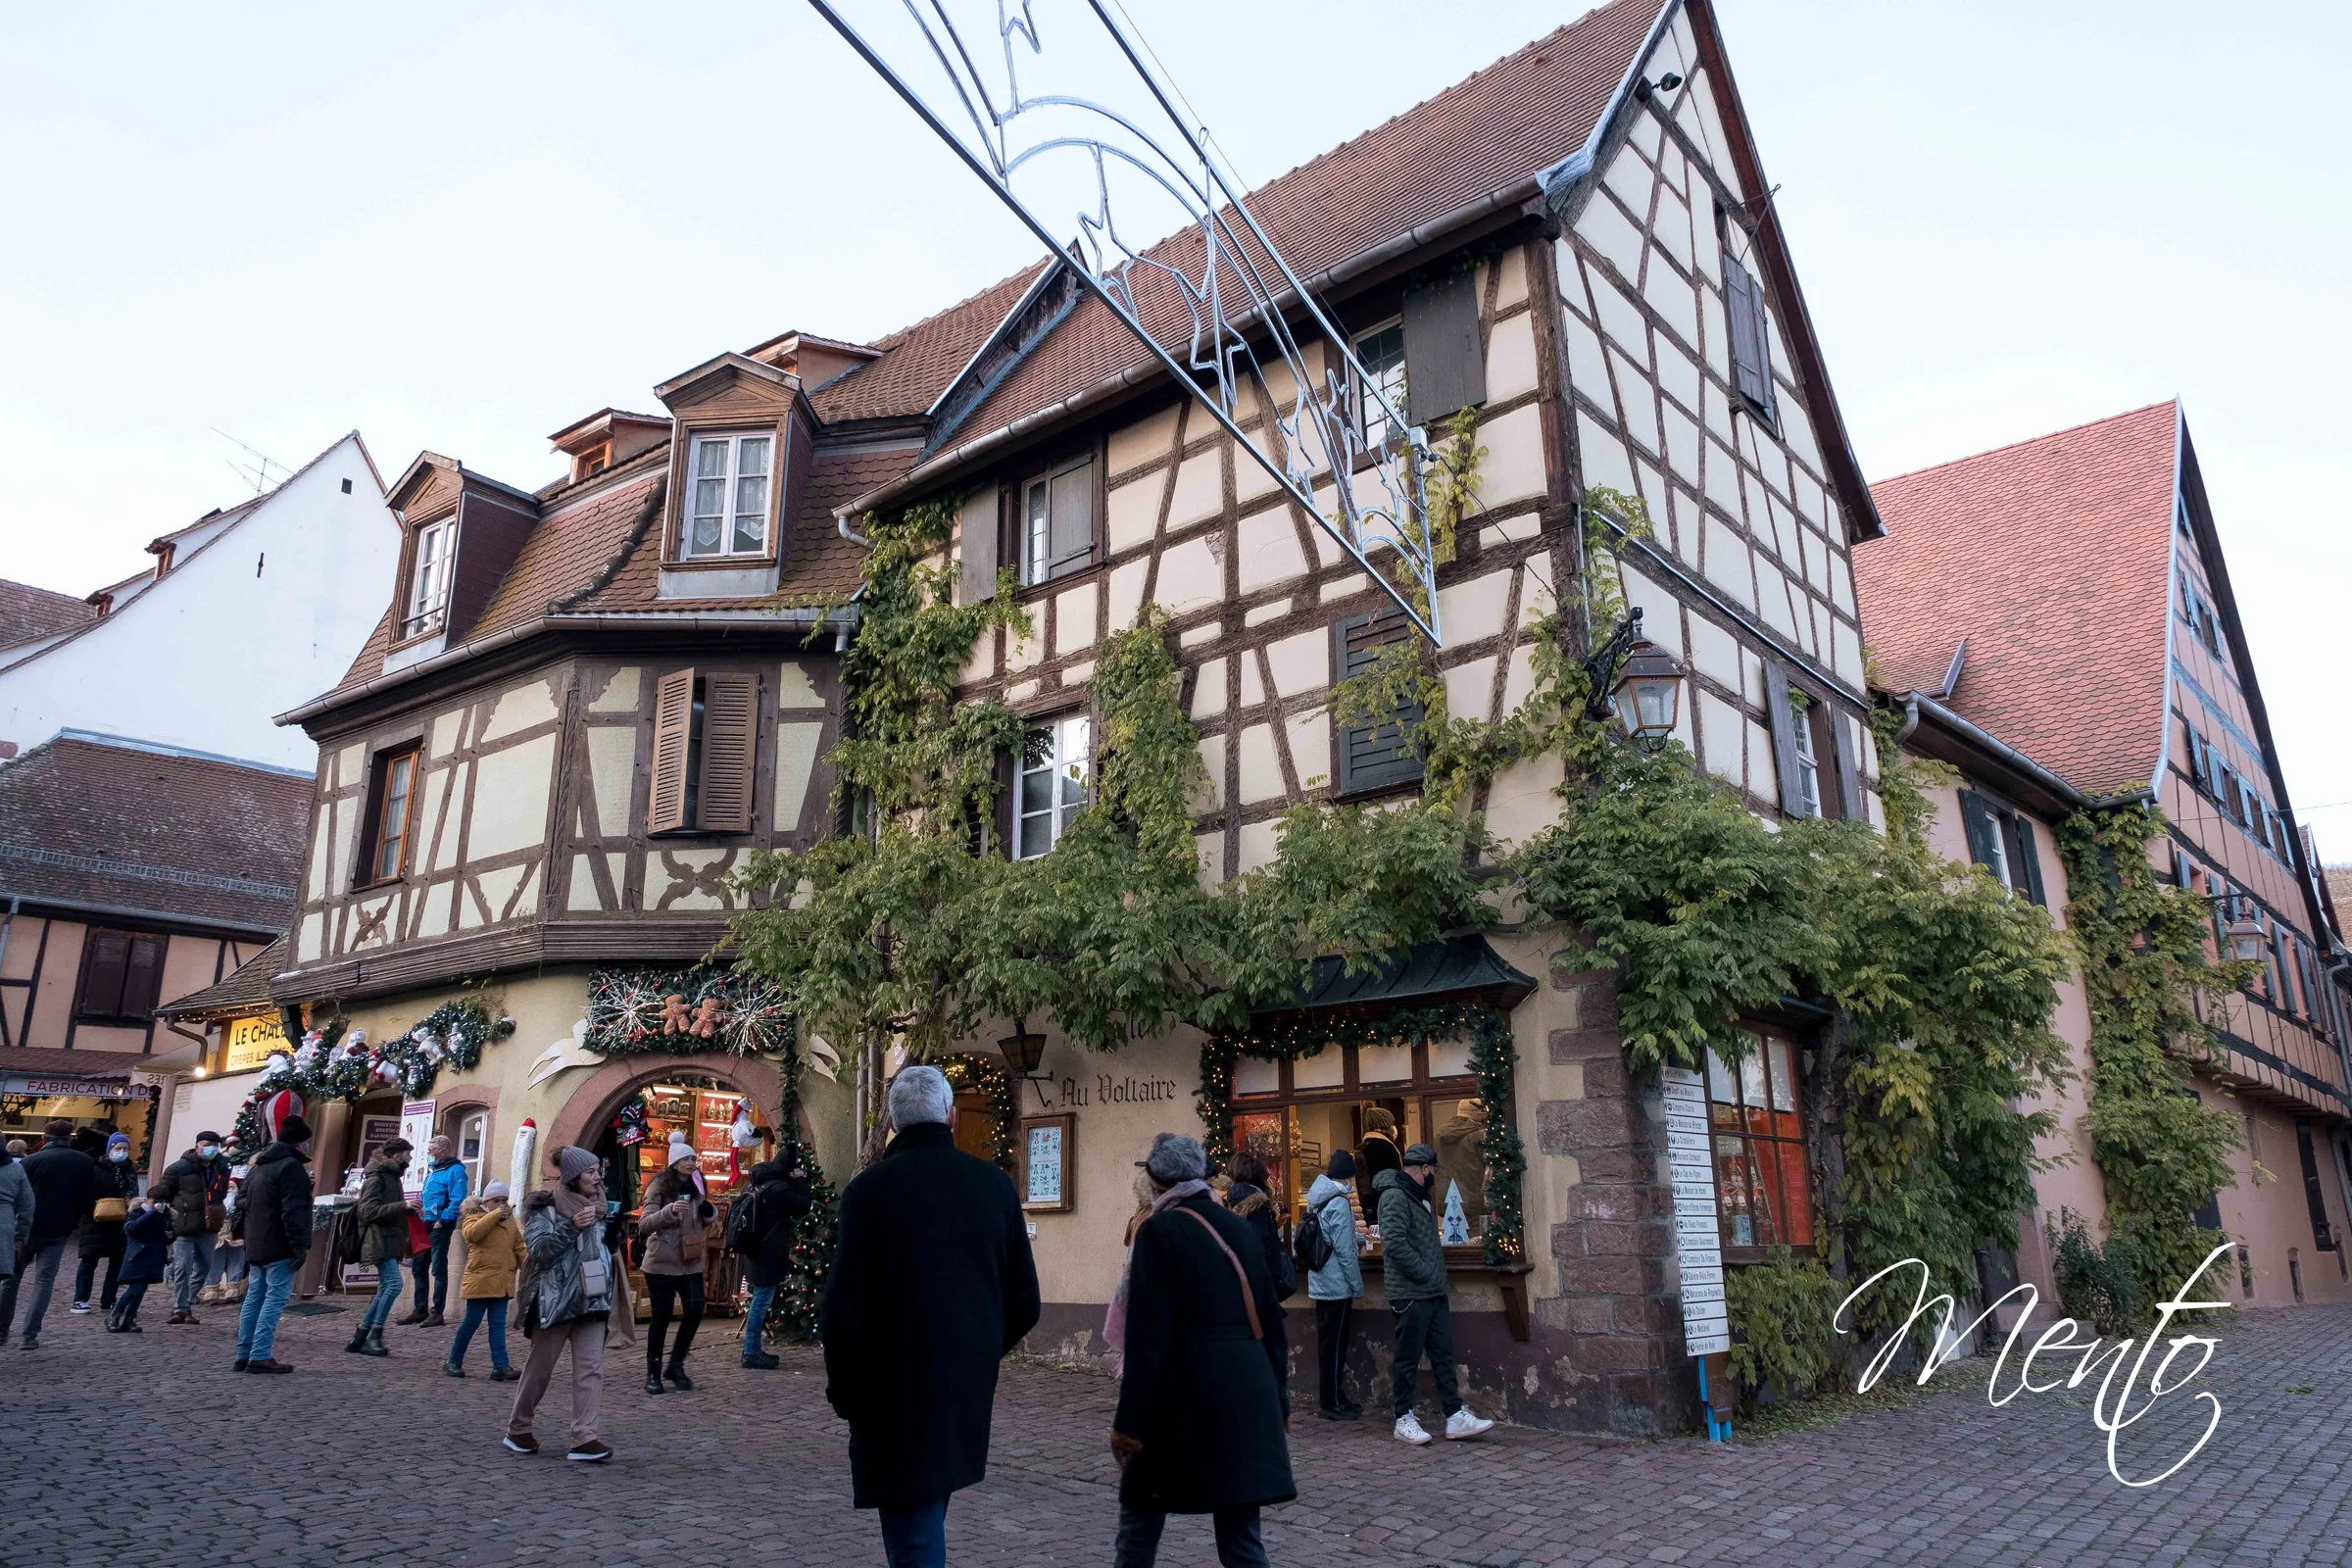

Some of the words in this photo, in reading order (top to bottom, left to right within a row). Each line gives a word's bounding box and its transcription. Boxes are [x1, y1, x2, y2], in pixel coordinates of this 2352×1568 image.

[235, 1027, 248, 1046] LE
[26, 1080, 134, 1096] FABRICATION
[1059, 1076, 1089, 1107] Au
[1097, 1073, 1177, 1105] Voltaire
